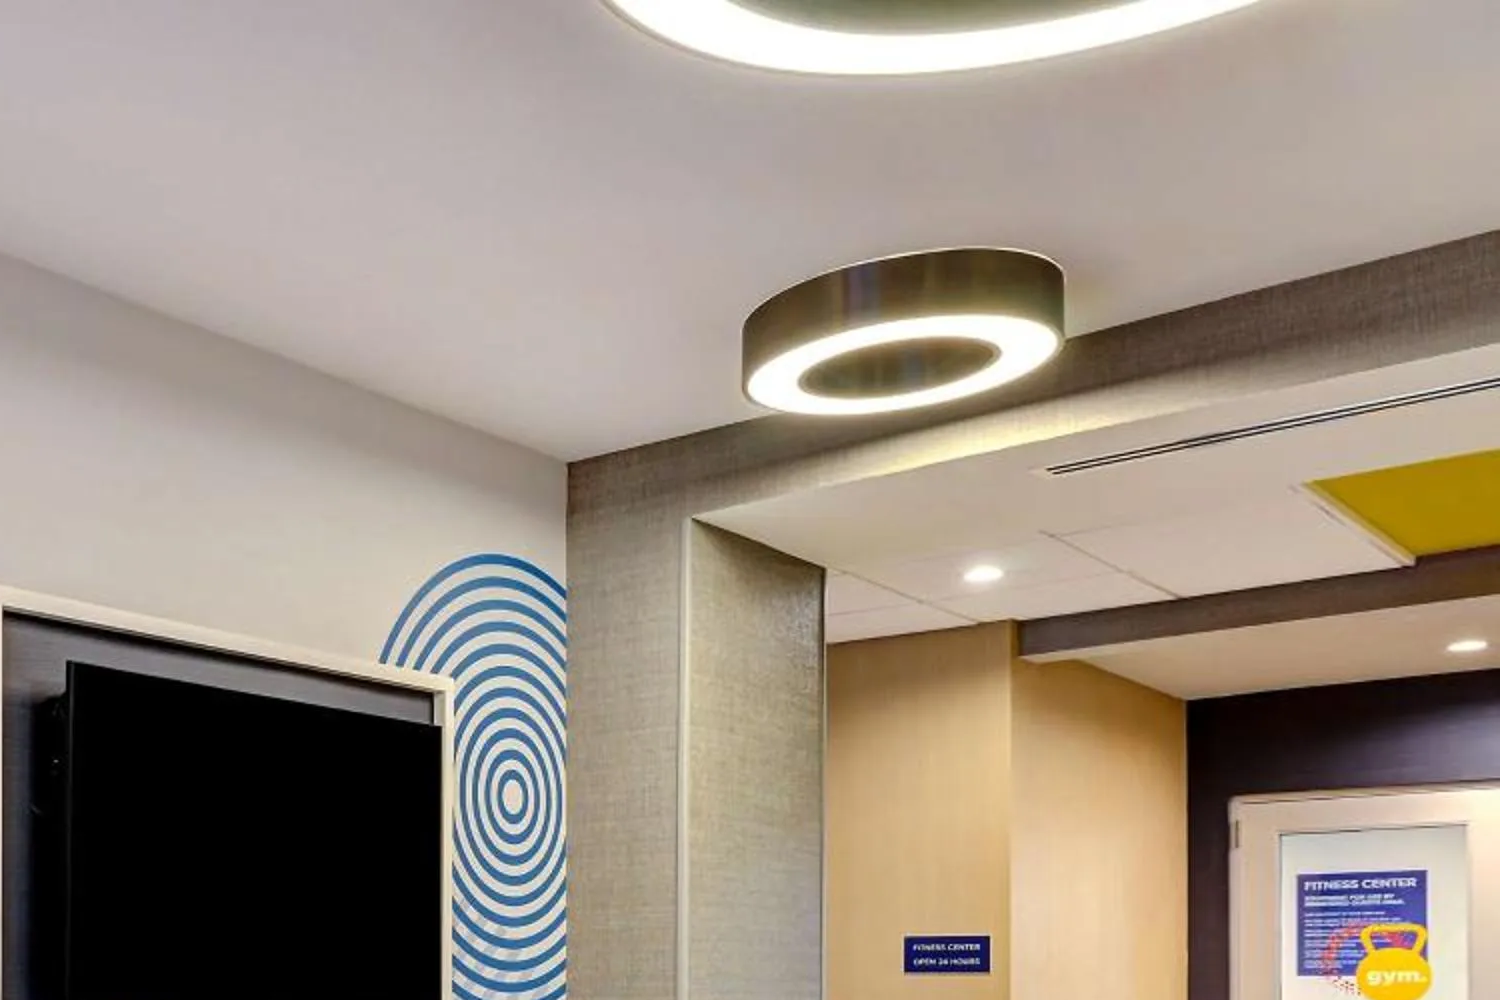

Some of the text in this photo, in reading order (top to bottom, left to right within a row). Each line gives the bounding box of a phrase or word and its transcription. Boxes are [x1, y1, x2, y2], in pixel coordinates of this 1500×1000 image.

[1304, 877, 1418, 891] FITNESS CENTER
[913, 943, 980, 951] FITNESS CENTER
[913, 957, 937, 966] OPEN
[949, 957, 980, 965] HOURS
[1367, 970, 1429, 987] gym.
